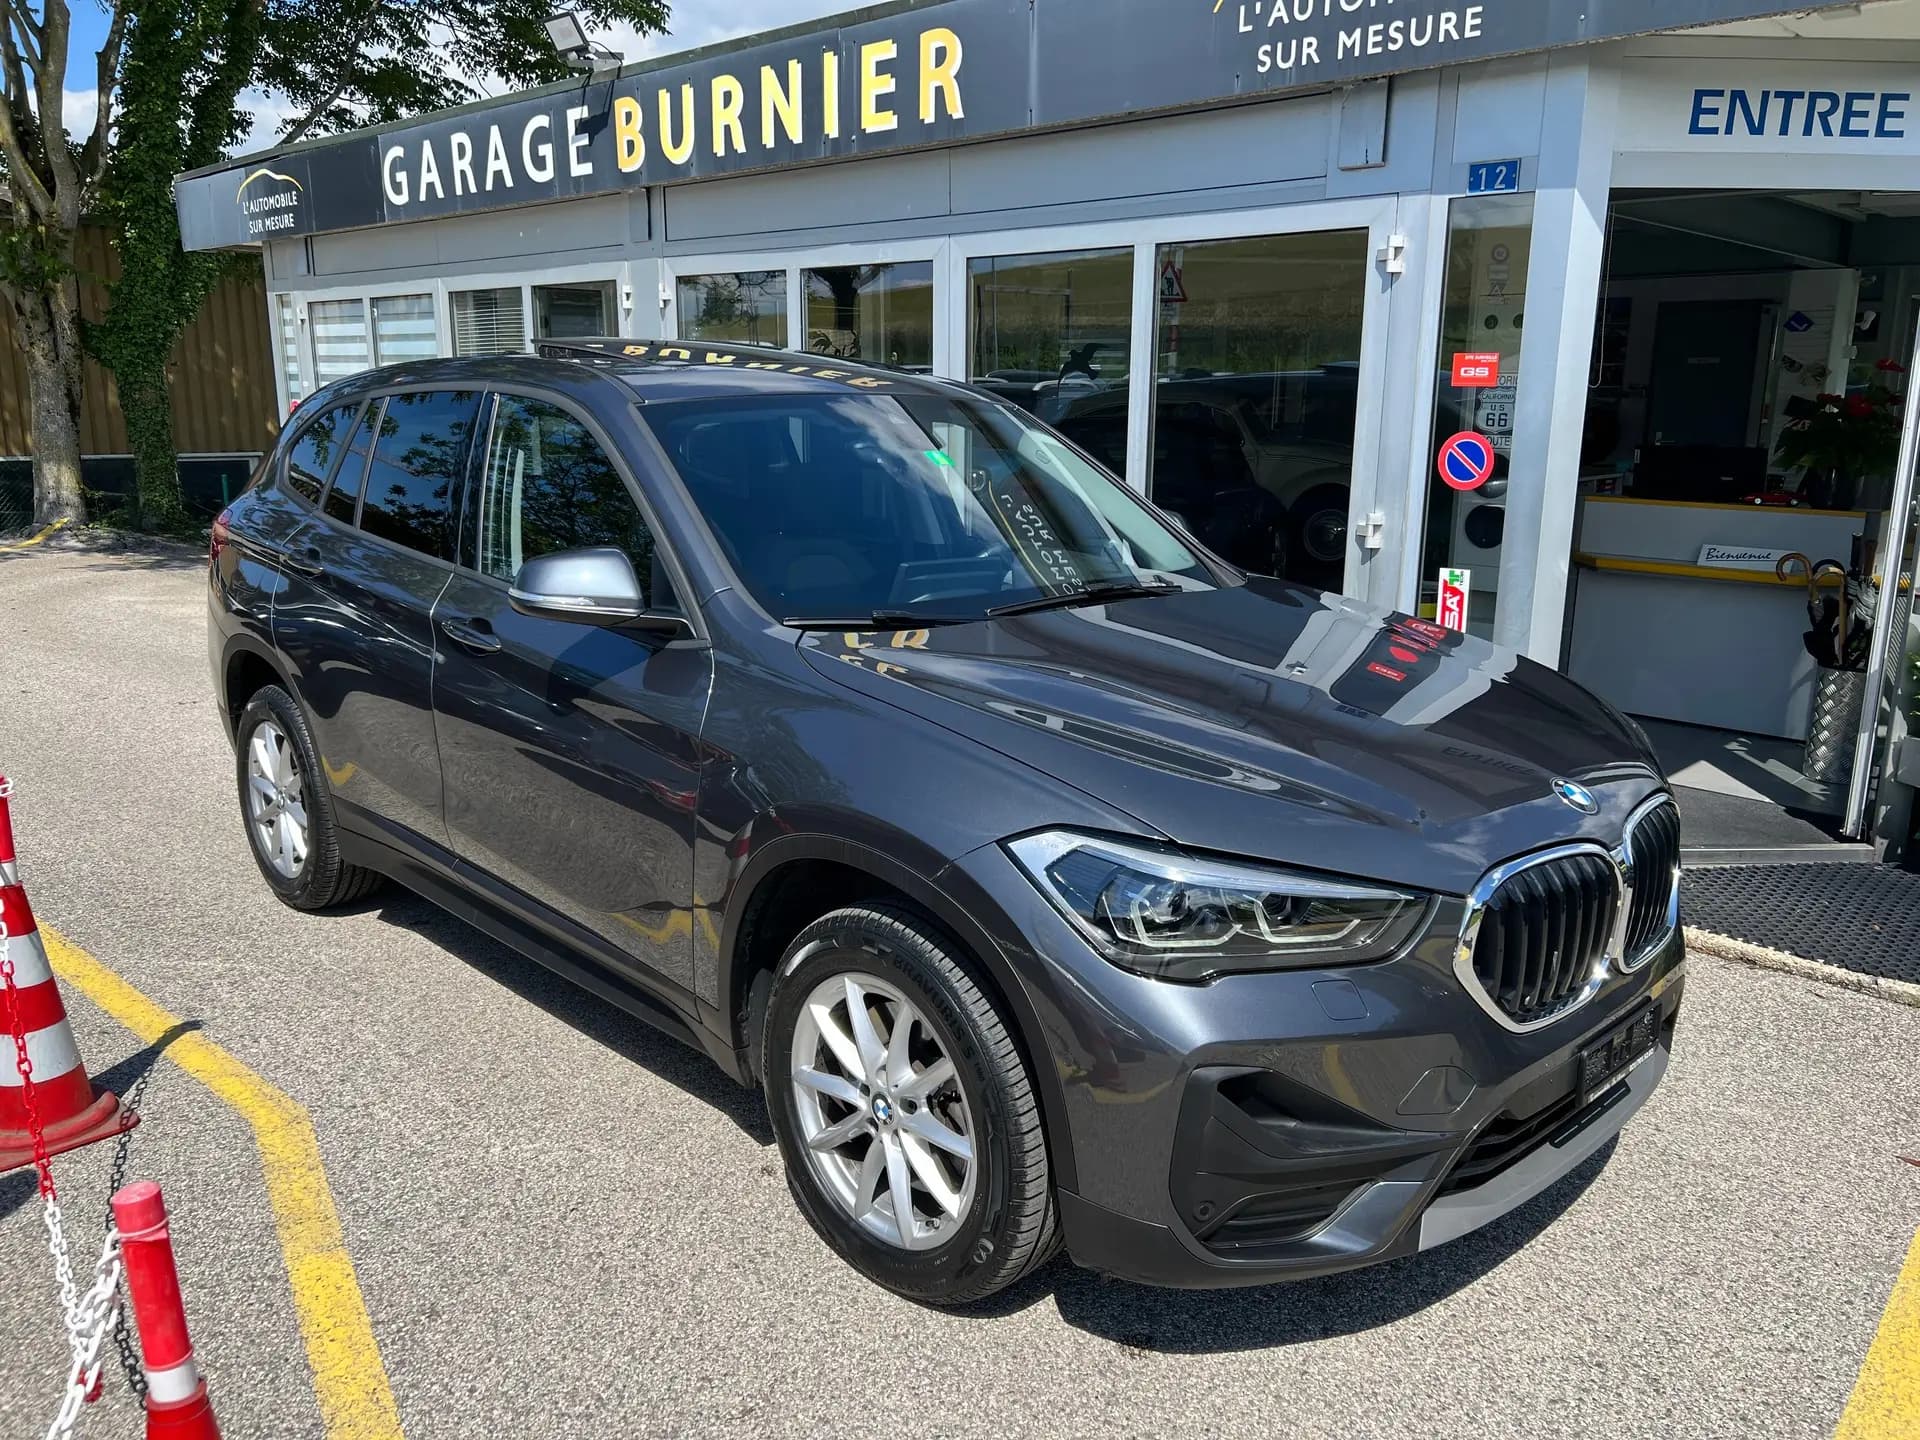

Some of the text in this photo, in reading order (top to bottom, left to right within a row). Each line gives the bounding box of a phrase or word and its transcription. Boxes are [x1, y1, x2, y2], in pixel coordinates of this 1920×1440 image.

[1257, 6, 1483, 73] SUR MESURE
[383, 27, 964, 205] GARAGE BURNIER
[1688, 89, 1910, 138] ENTREE
[1479, 166, 1507, 190] 12
[242, 191, 298, 215] L'AUTOMOBILE
[249, 213, 295, 234] SUR MESURE
[1460, 367, 1489, 376] GS
[1486, 413, 1508, 427] 66
[1486, 436, 1511, 446] OUTE
[1705, 547, 1772, 561] Bienvenue
